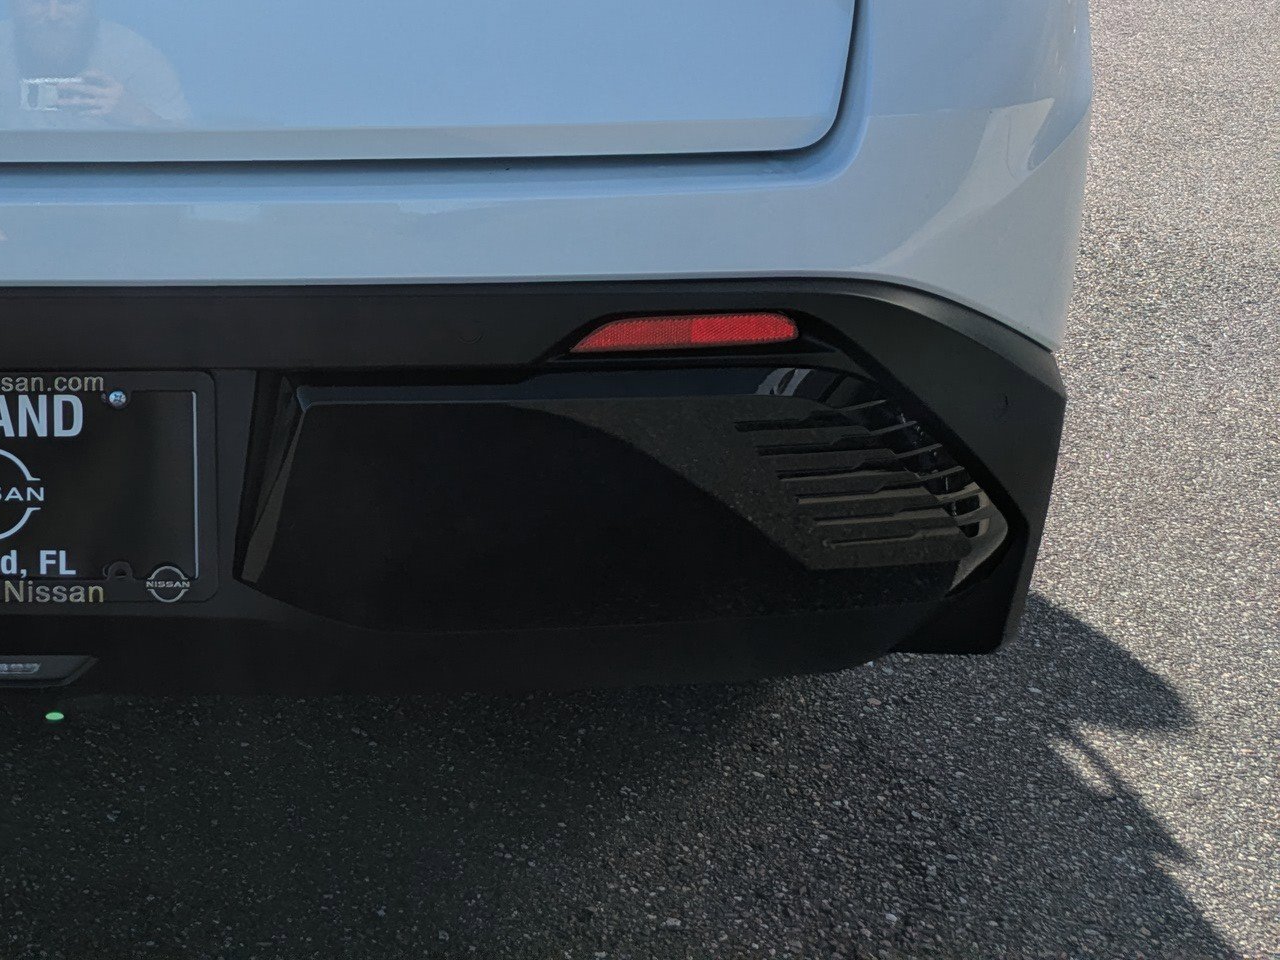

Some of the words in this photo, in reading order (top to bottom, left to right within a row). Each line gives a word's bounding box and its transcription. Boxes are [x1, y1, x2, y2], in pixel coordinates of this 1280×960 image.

[39, 550, 77, 575] FL
[5, 581, 104, 603] Nissan
[145, 580, 191, 588] NISSAN
